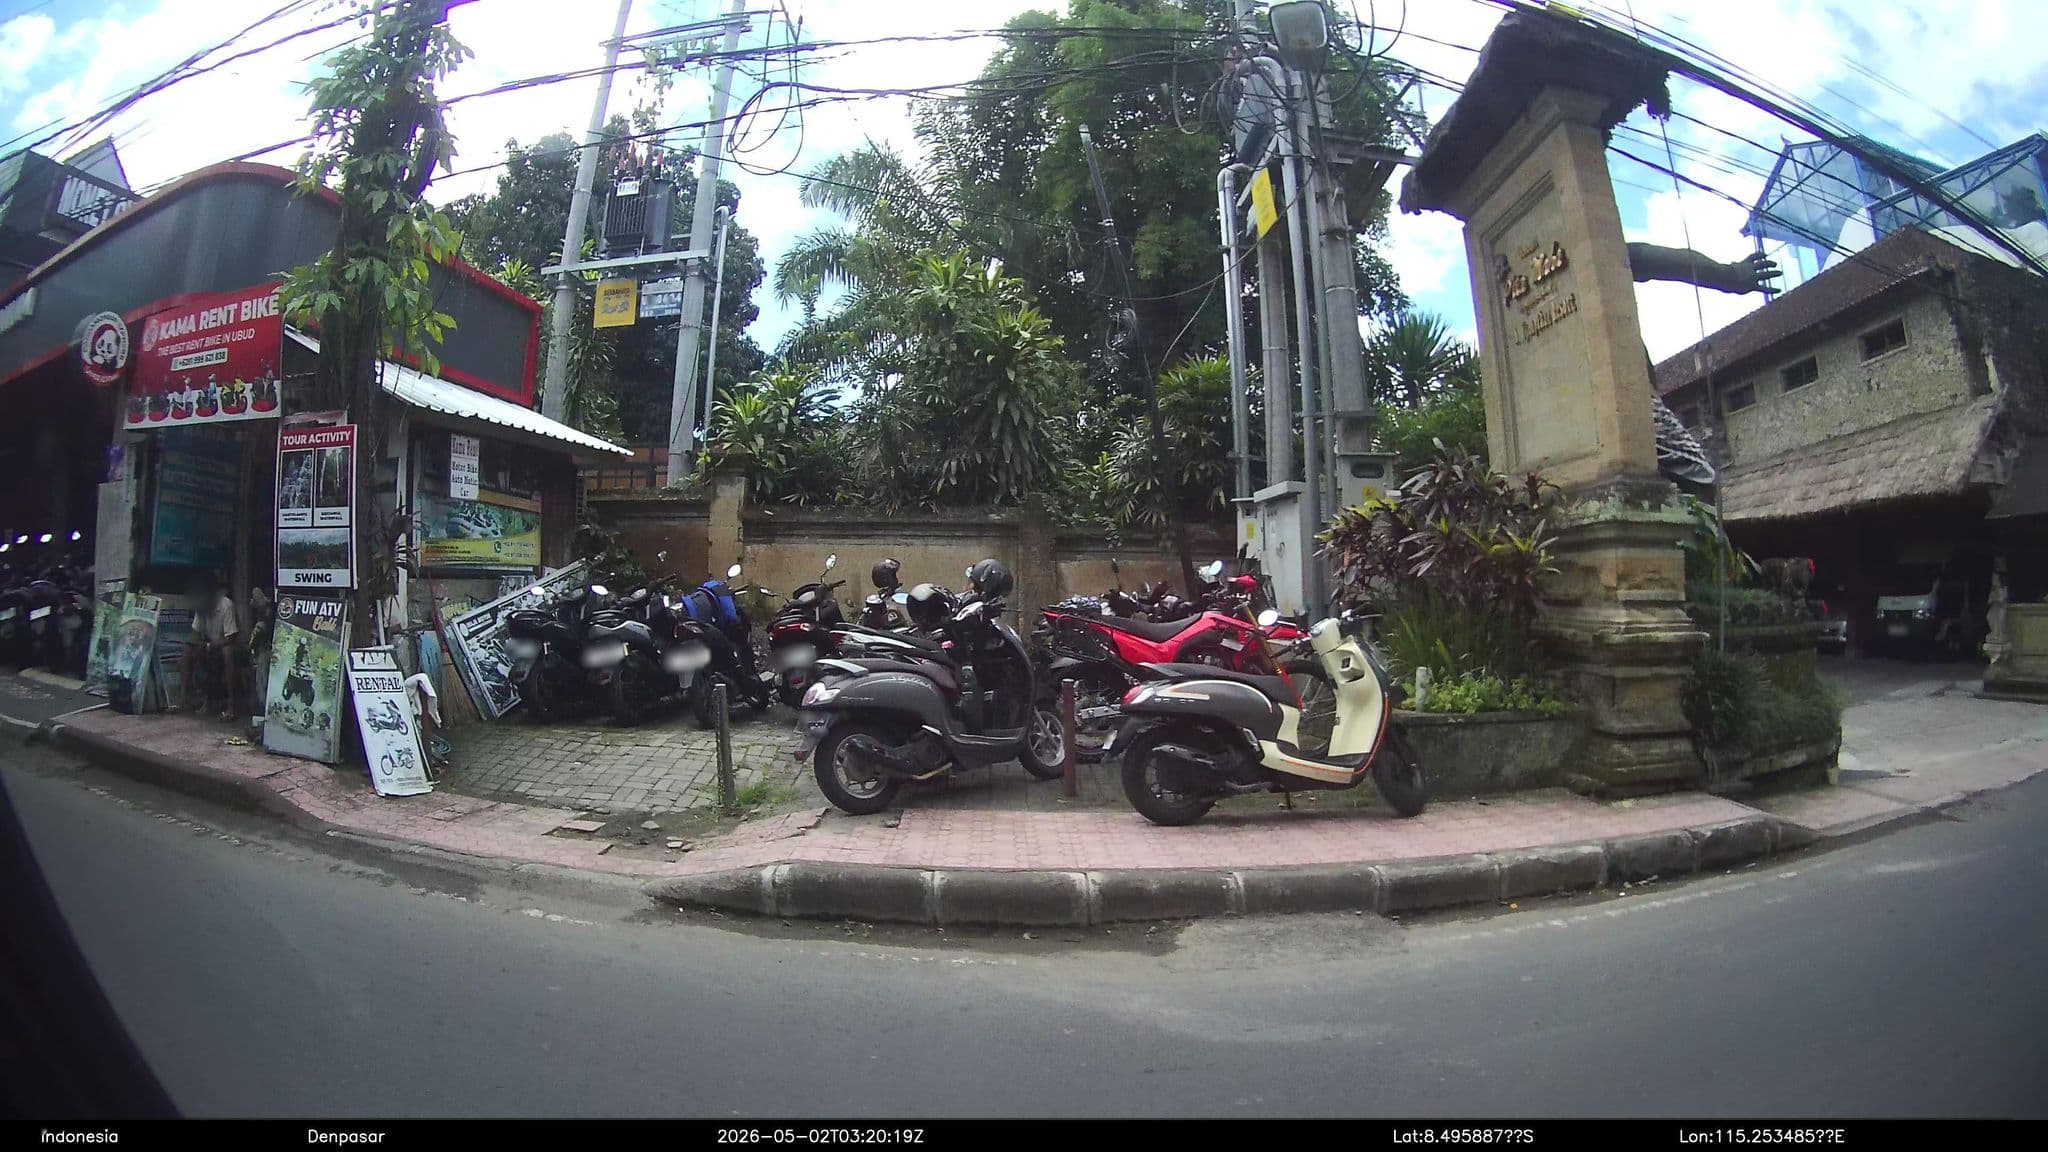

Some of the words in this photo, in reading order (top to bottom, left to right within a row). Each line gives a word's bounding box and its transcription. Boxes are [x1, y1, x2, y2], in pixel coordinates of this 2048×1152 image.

[159, 315, 196, 340] KAMA
[199, 303, 238, 331] RENT
[240, 294, 280, 321] BIKE
[204, 334, 222, 348] BIKE
[222, 332, 231, 344] IN
[231, 328, 256, 342] UBUD
[282, 434, 307, 446] TOUR
[308, 431, 352, 444] ACTIVITY
[294, 573, 332, 583] SWING
[295, 600, 318, 615] FUN
[318, 602, 342, 617] ATV
[355, 677, 402, 691] RENTAL
